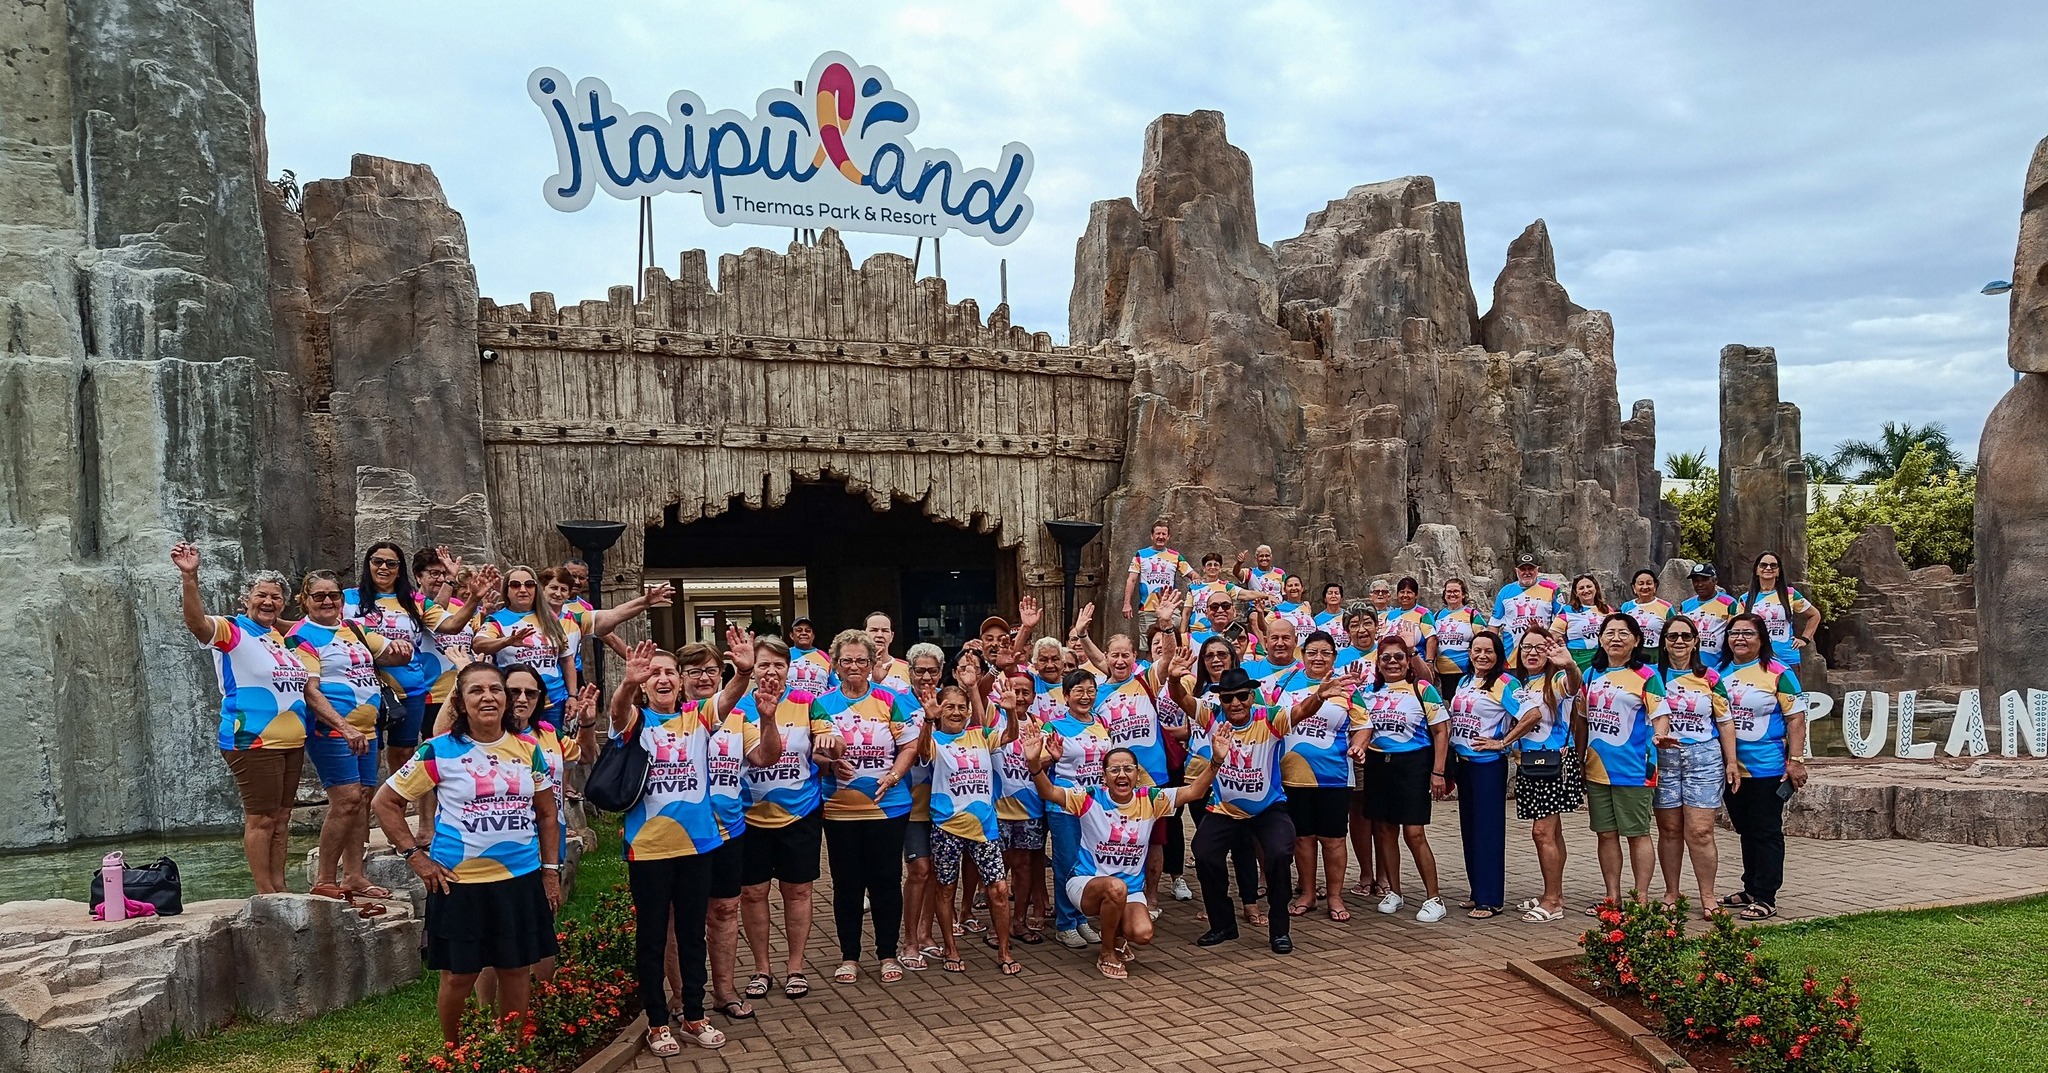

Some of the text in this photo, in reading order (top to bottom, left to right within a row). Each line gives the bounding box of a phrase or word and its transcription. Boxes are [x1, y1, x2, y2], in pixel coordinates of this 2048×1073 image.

[732, 195, 937, 226] Thermas Park & Resort
[273, 682, 304, 692] VIVE
[349, 678, 379, 688] VIVE
[710, 762, 739, 771] LIMITA
[748, 768, 800, 783] VIVER
[1075, 776, 1104, 785] VIVE
[645, 778, 698, 796] VIVER
[950, 784, 990, 796] VIVER
[1219, 777, 1263, 793] VIVER
[461, 816, 530, 833] VIVER
[1095, 854, 1140, 866] VIVER
